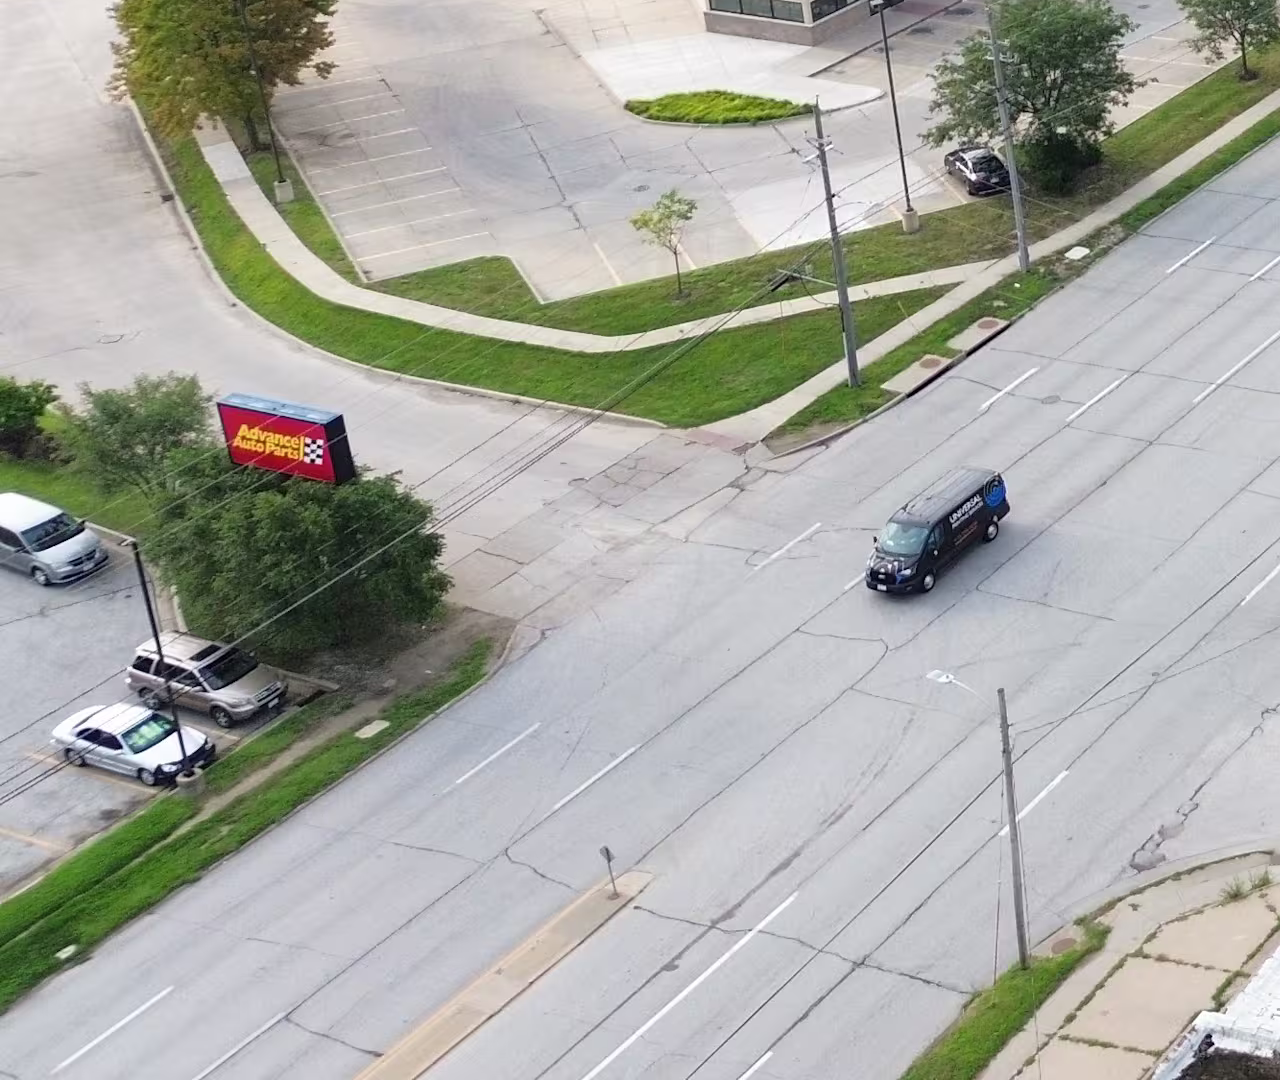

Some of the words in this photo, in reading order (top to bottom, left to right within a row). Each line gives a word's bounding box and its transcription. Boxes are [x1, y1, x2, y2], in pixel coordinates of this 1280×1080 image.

[233, 435, 265, 454] Auto
[265, 442, 299, 460] Parts
[237, 423, 300, 449] Advance
[949, 493, 983, 524] UNIVERSAL
